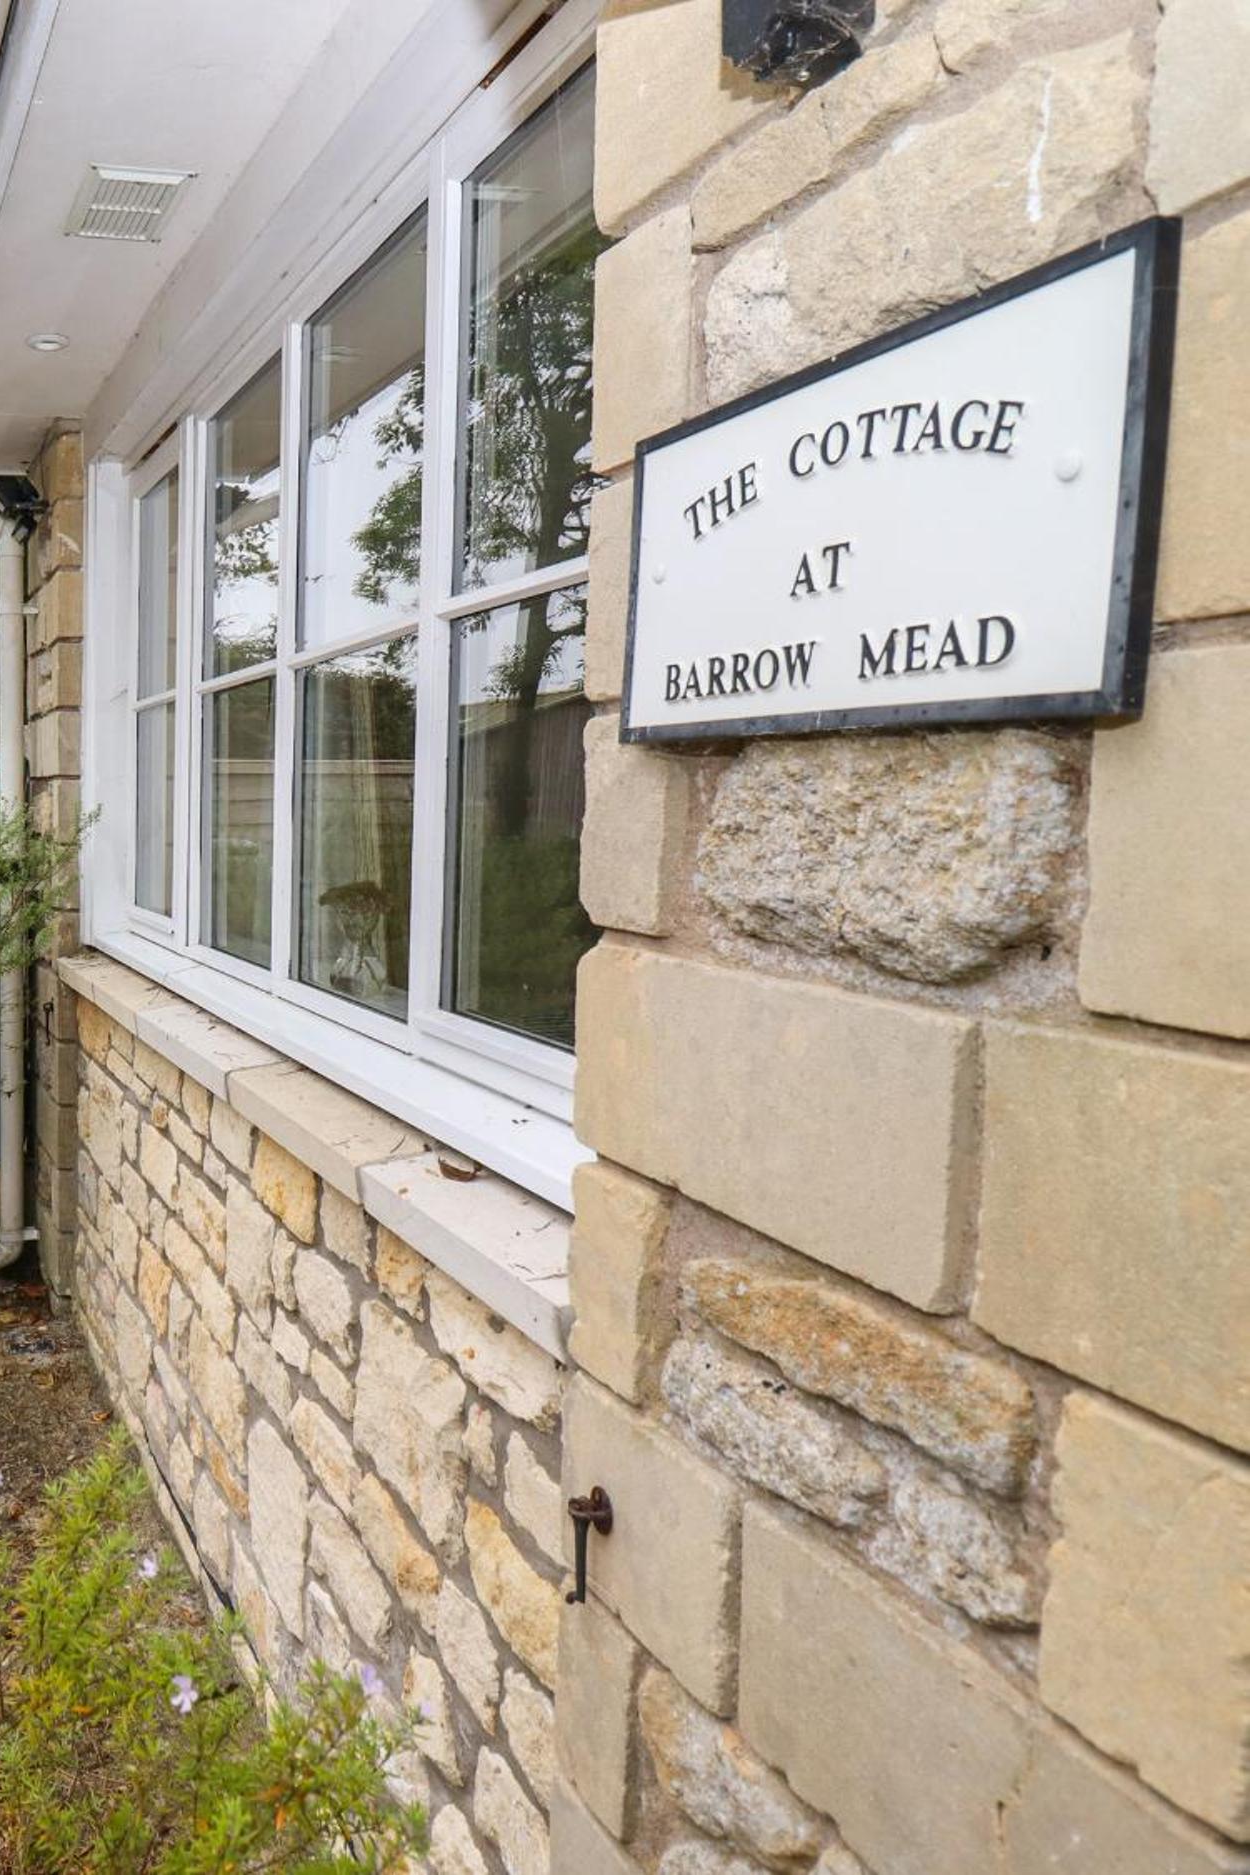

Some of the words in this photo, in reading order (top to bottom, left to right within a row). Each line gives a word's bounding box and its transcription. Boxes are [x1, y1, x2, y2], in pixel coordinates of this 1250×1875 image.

[683, 462, 758, 541] THE
[787, 400, 1024, 478] COTTAGE
[789, 542, 851, 598] AT
[664, 640, 817, 702] BARROW
[857, 615, 1016, 680] MEAD
